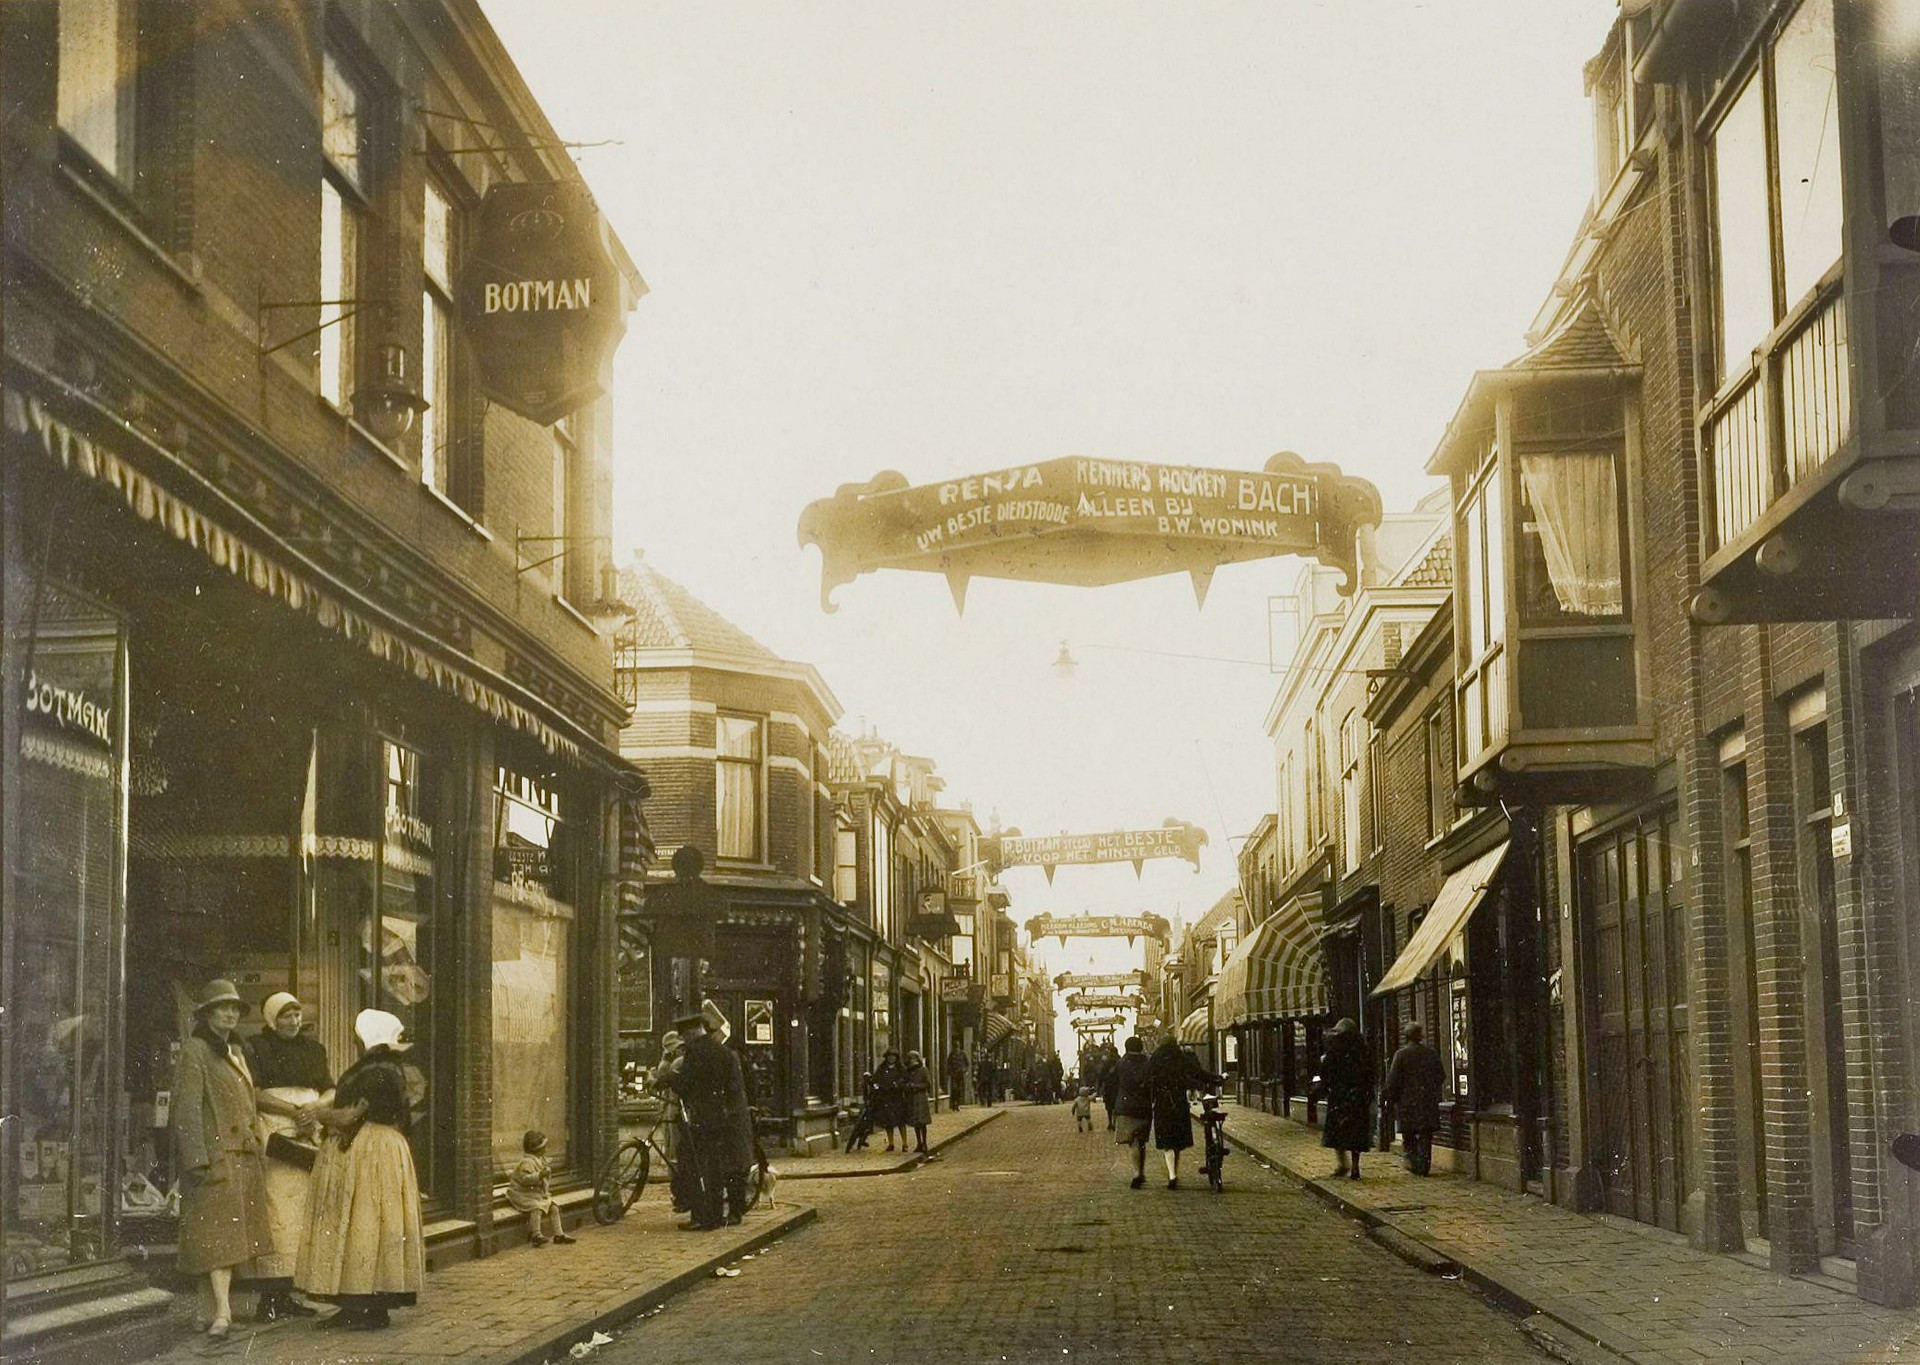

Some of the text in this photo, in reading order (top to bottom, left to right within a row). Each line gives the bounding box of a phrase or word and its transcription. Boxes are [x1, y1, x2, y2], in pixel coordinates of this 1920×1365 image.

[484, 278, 591, 314] BOTMAN
[1076, 491, 1156, 517] ALLEEN
[916, 500, 1071, 552] UW BESTE DIENSTBODE
[1199, 517, 1279, 537] WONINK
[1124, 830, 1174, 846] BESTE
[1096, 846, 1146, 859] MINSTE
